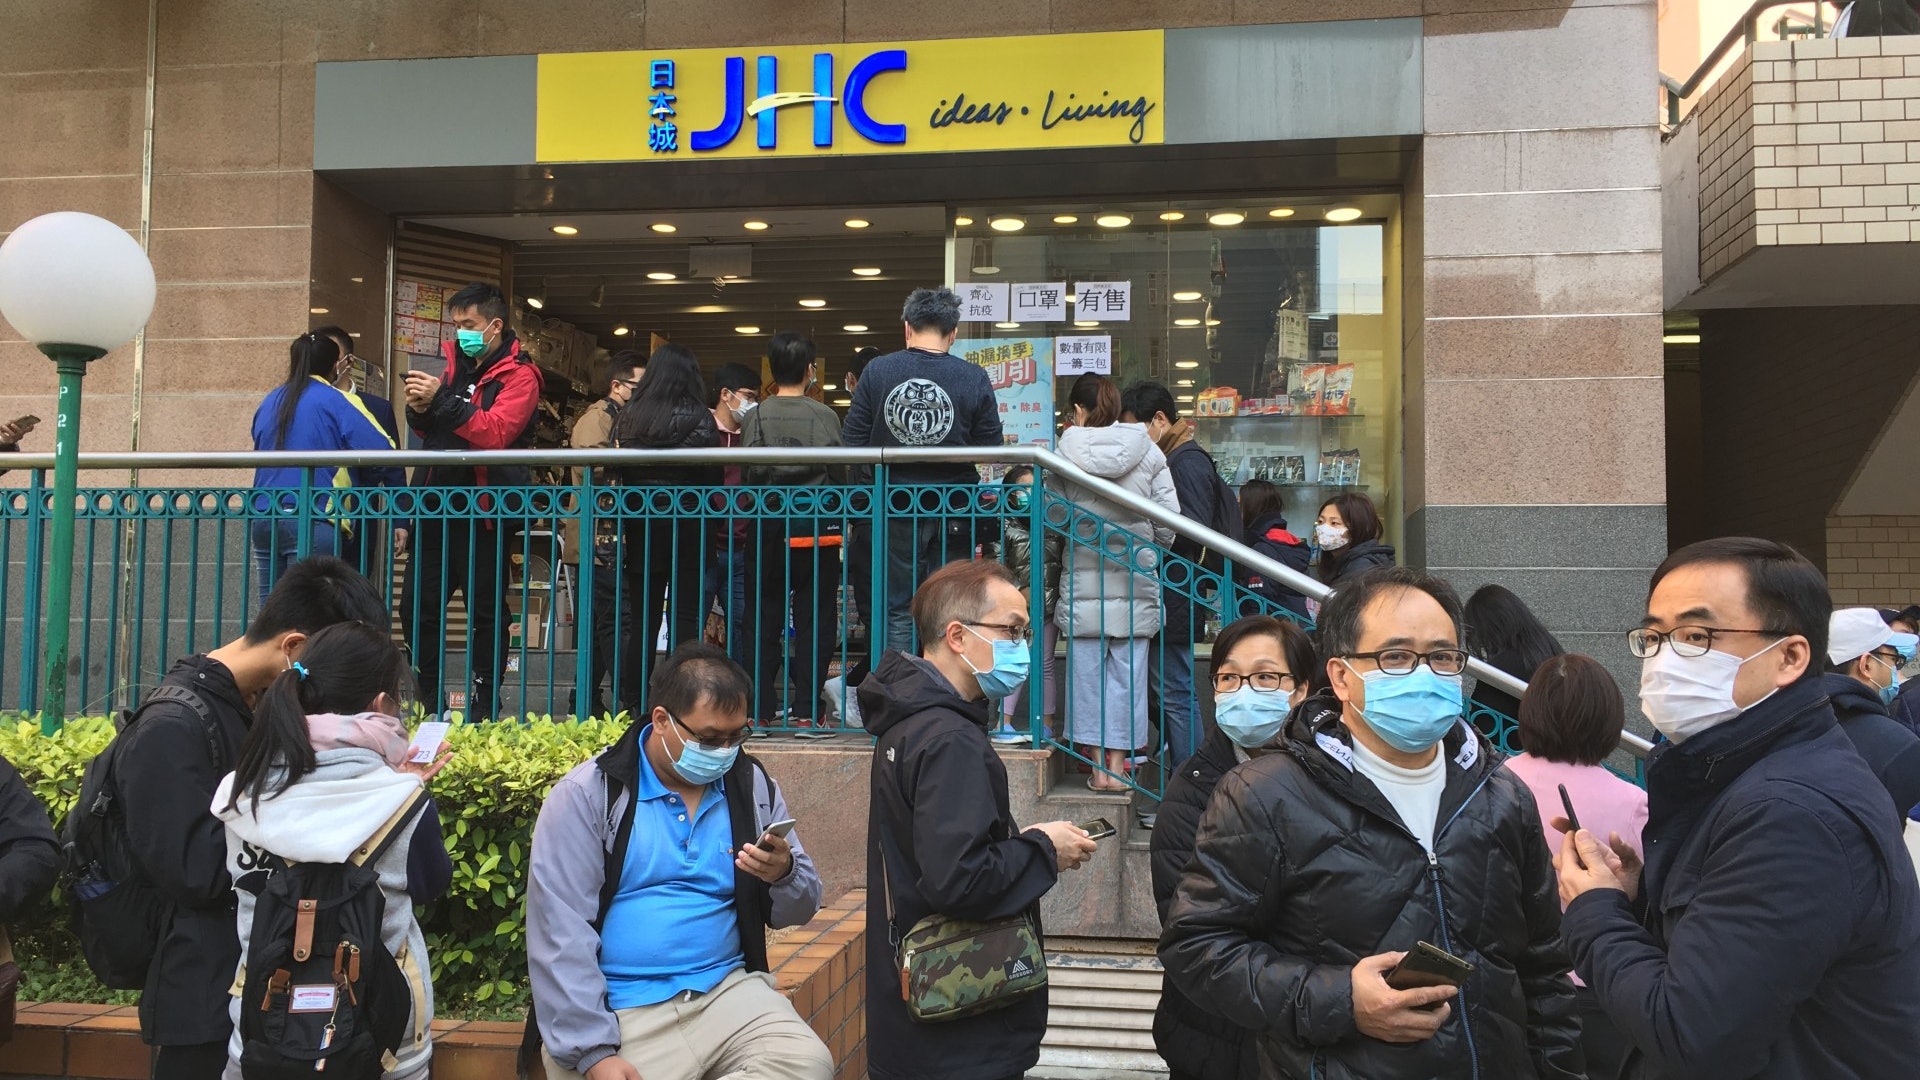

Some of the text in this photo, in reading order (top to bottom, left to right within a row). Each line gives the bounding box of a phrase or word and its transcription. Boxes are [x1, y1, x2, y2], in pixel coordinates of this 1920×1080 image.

[649, 60, 677, 152] 日本城
[690, 49, 907, 151] JHC
[930, 90, 1156, 143] ideas Living
[970, 289, 993, 301] 齊心
[1019, 290, 1059, 310] 口罩
[1078, 289, 1126, 312] 有售
[969, 304, 993, 317] 抗疫
[1059, 341, 1107, 354] 數量有限
[1008, 969, 1033, 979] GREGORY
